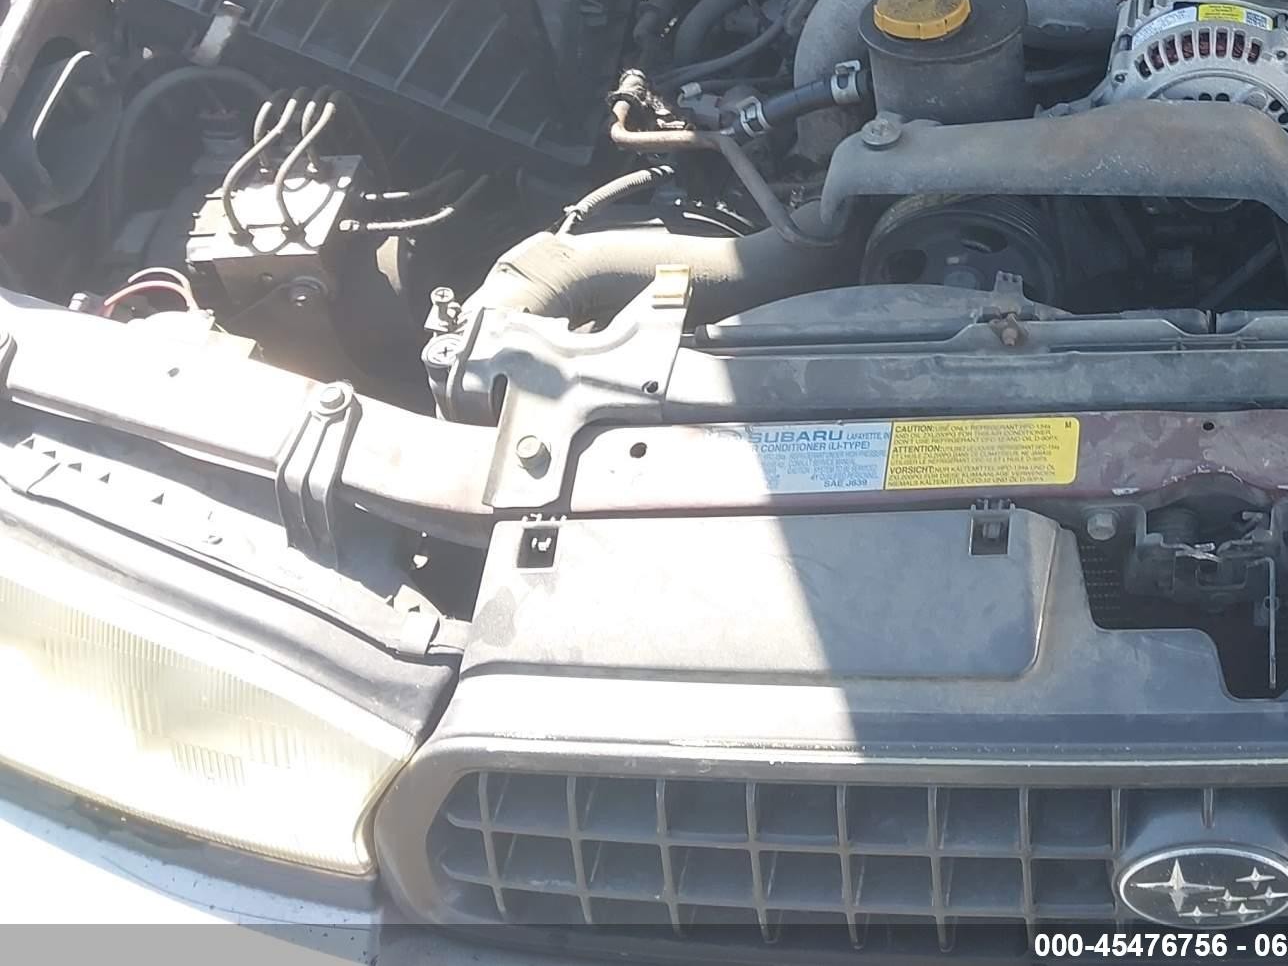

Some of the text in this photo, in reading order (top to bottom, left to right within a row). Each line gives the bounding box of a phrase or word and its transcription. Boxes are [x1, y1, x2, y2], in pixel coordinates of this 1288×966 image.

[895, 425, 934, 433] CAUTION:
[751, 430, 843, 443] SUBARU
[761, 442, 826, 453] CONDITIONER
[828, 440, 871, 451] (LI-TYPE)
